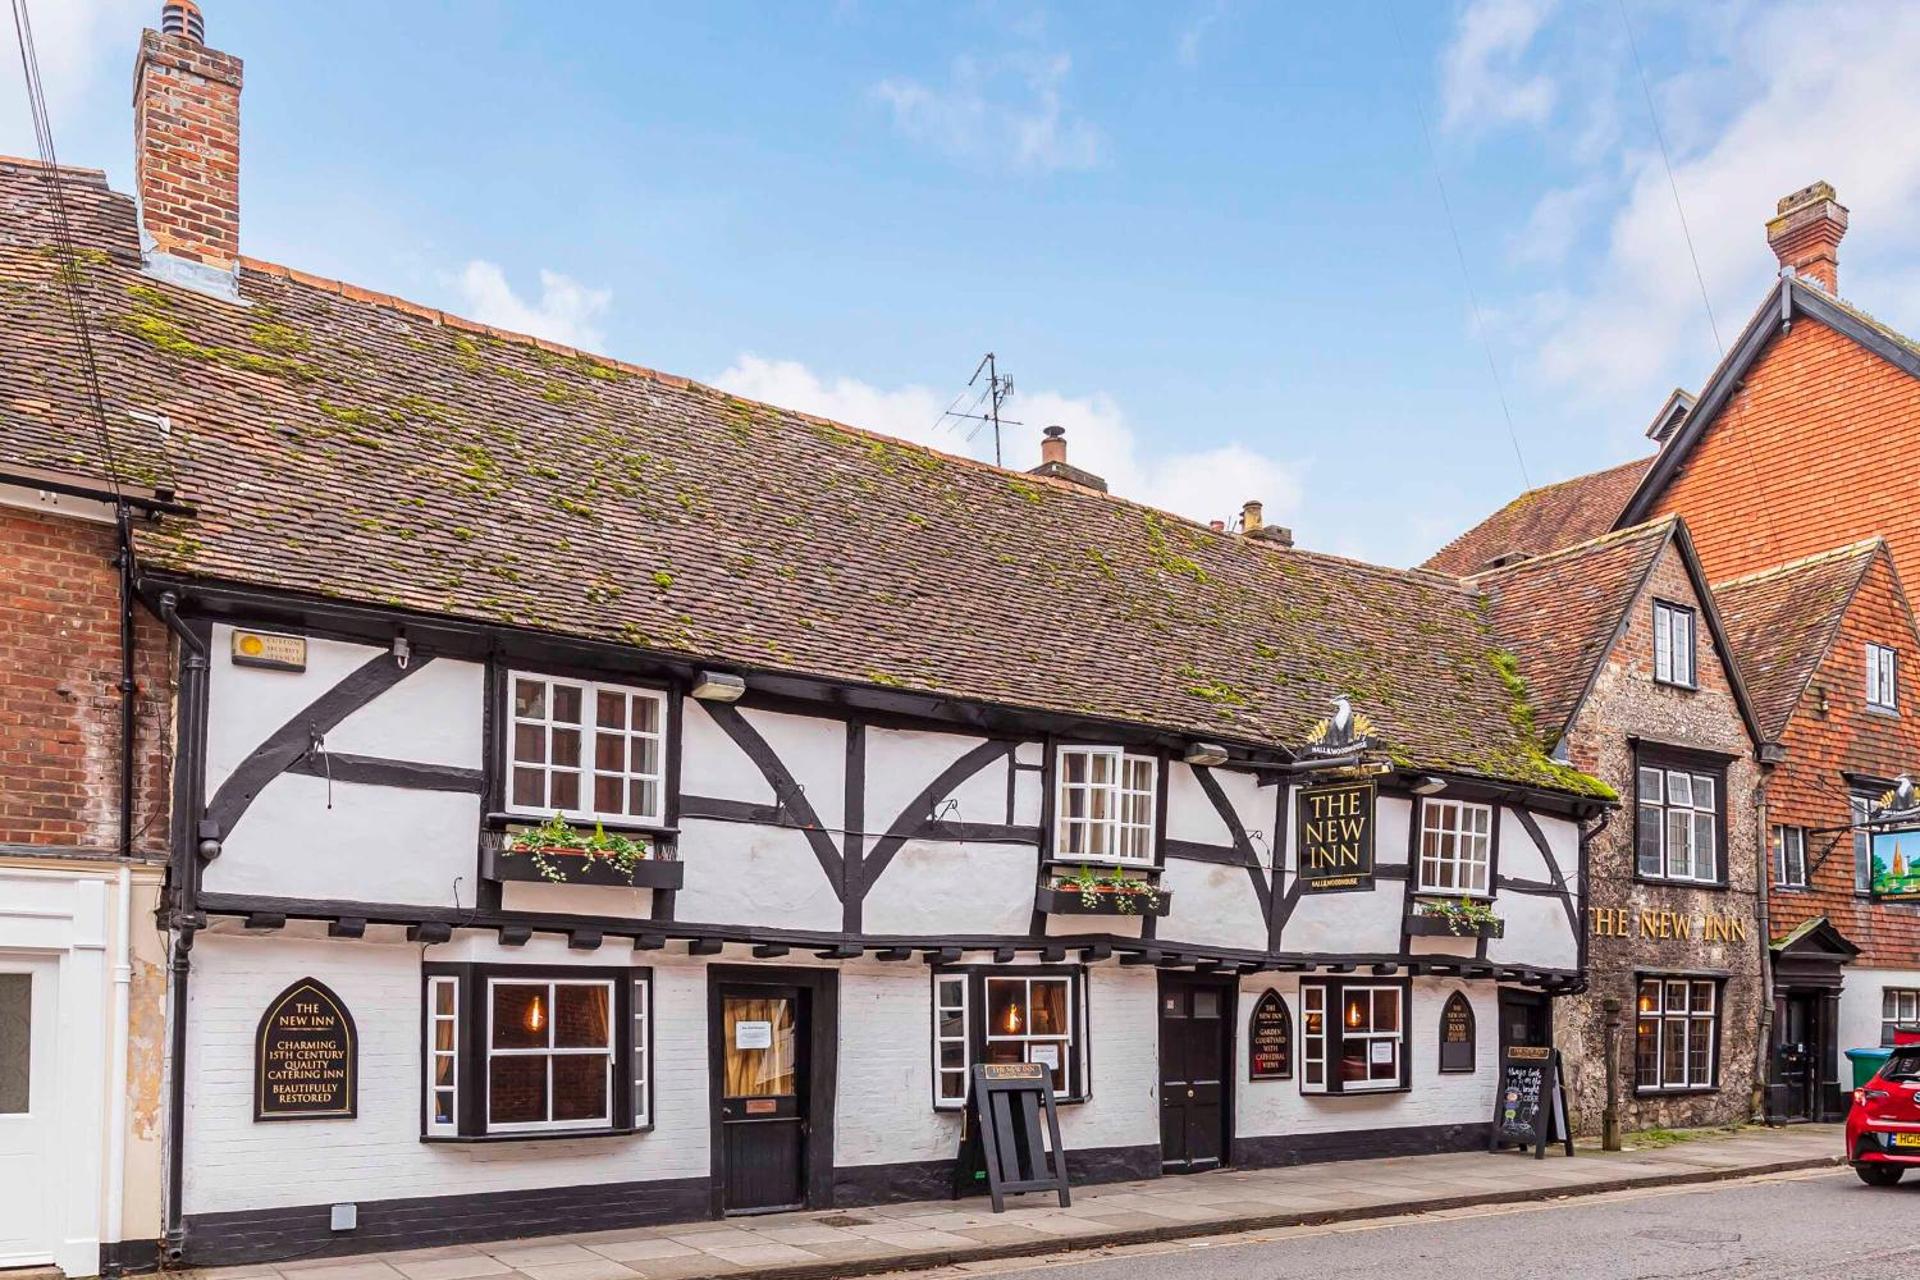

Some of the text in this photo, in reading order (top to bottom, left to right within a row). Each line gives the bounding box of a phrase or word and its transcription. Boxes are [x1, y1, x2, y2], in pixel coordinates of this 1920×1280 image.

[1310, 792, 1361, 819] THE
[1306, 817, 1366, 844] NEW
[1310, 843, 1359, 869] INN
[1640, 908, 1692, 940] NEW
[1704, 913, 1747, 942] INN
[296, 1003, 319, 1014] THE
[280, 1016, 335, 1026] NEW INN
[1259, 1028, 1281, 1036] GARDEN
[277, 1040, 337, 1050] CHARMING
[269, 1050, 345, 1060] 15TH CENTURY
[284, 1060, 329, 1071] QUALITY
[268, 1070, 344, 1080] CATERING INN
[273, 1084, 339, 1094] BEAUTIFULLY
[279, 1093, 332, 1103] RESTORED
